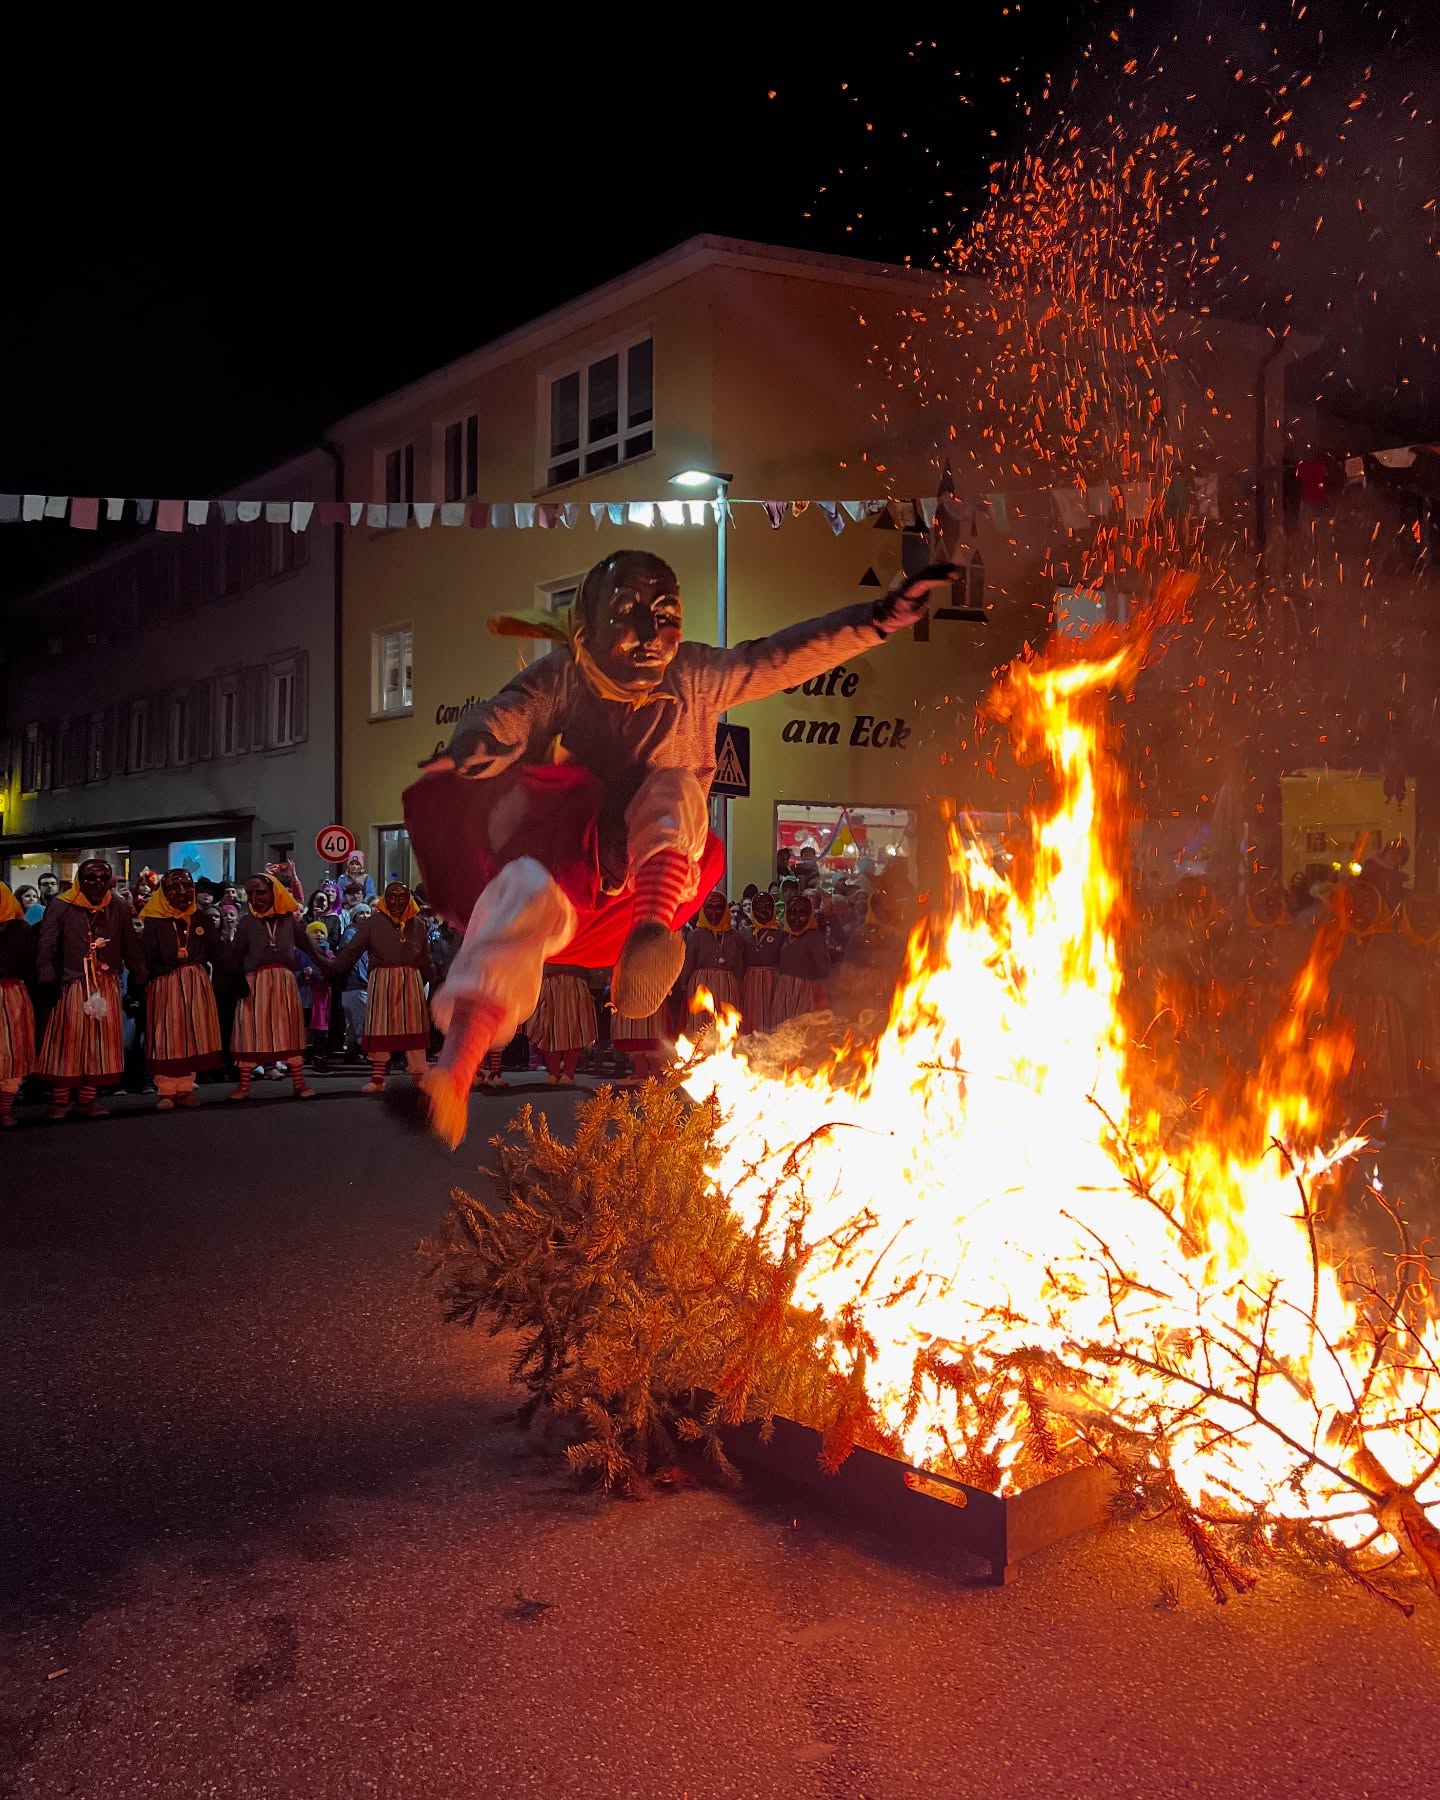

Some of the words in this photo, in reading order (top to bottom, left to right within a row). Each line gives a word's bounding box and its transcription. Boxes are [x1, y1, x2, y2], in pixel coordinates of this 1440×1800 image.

[782, 665, 859, 697] afe
[781, 719, 841, 745] am
[849, 715, 911, 749] Eck
[324, 835, 347, 852] 40
